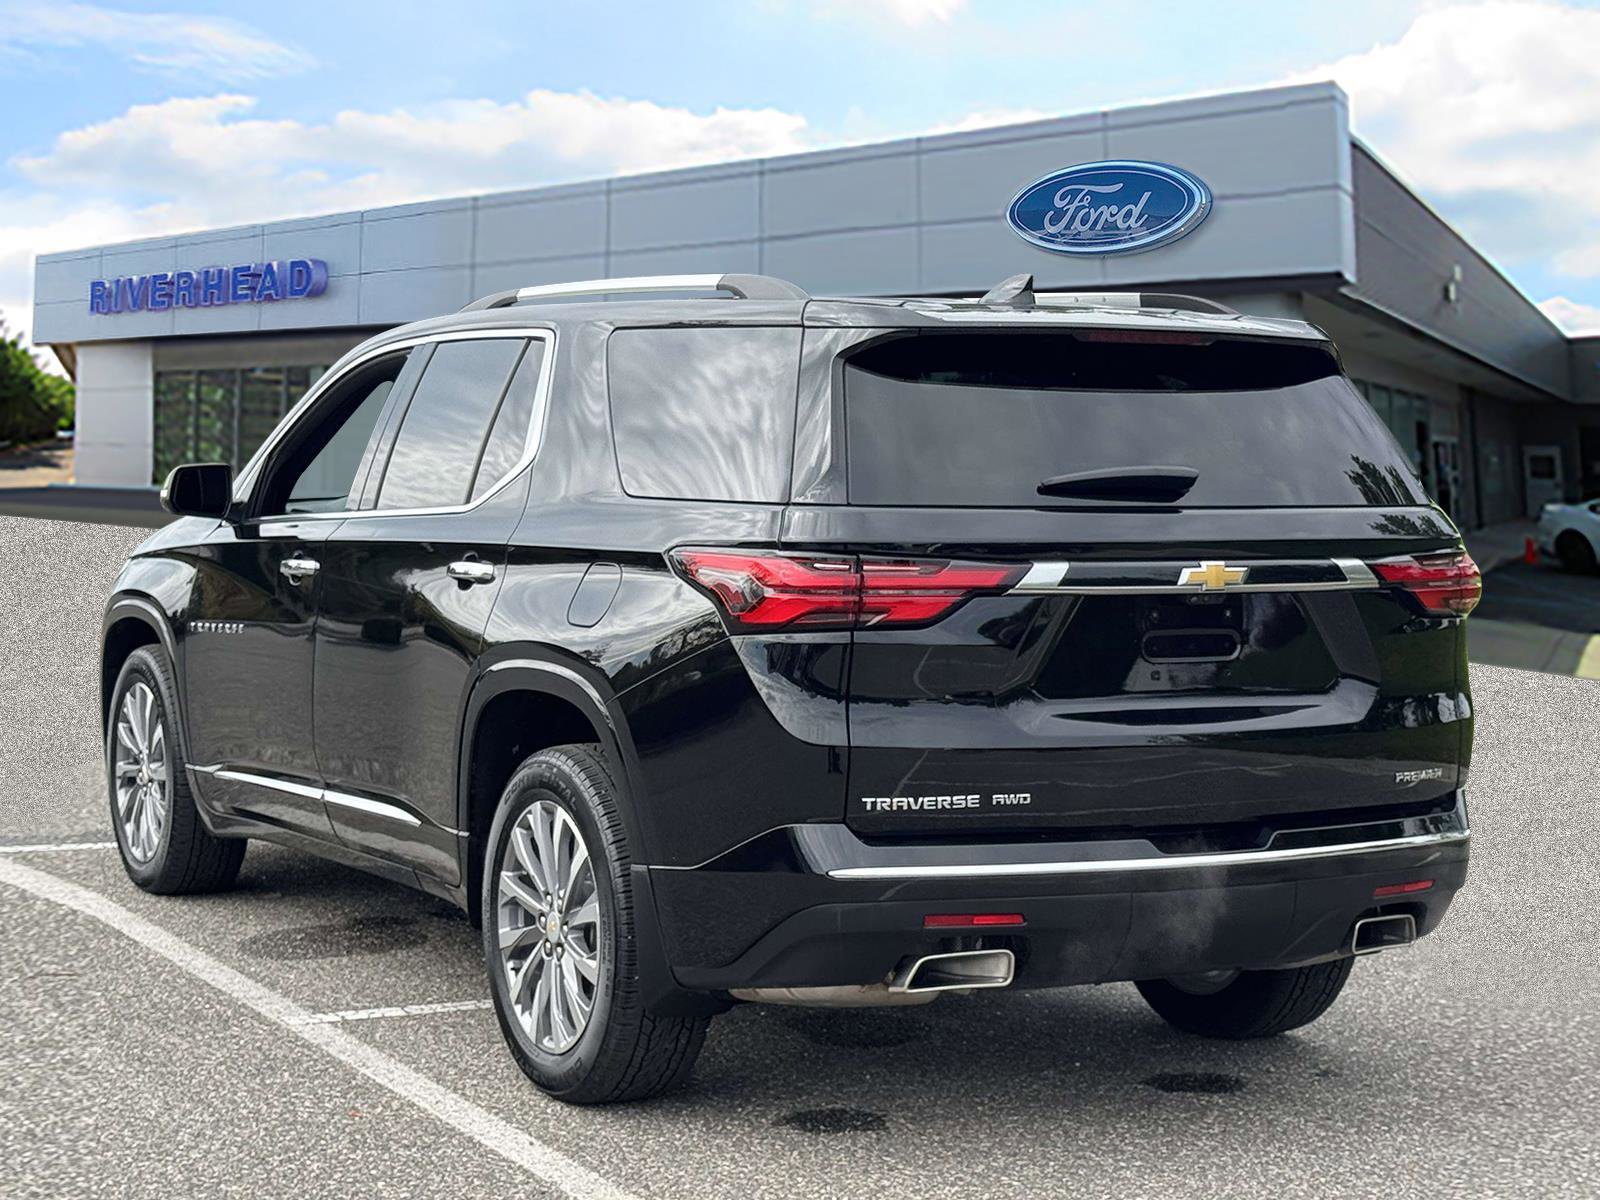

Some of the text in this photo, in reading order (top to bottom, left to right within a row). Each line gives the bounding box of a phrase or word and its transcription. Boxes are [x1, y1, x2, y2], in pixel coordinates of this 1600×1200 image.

[1043, 182, 1152, 234] Ford
[89, 259, 327, 315] RIVERHEAD
[861, 793, 1031, 811] TRAVERSE AWD
